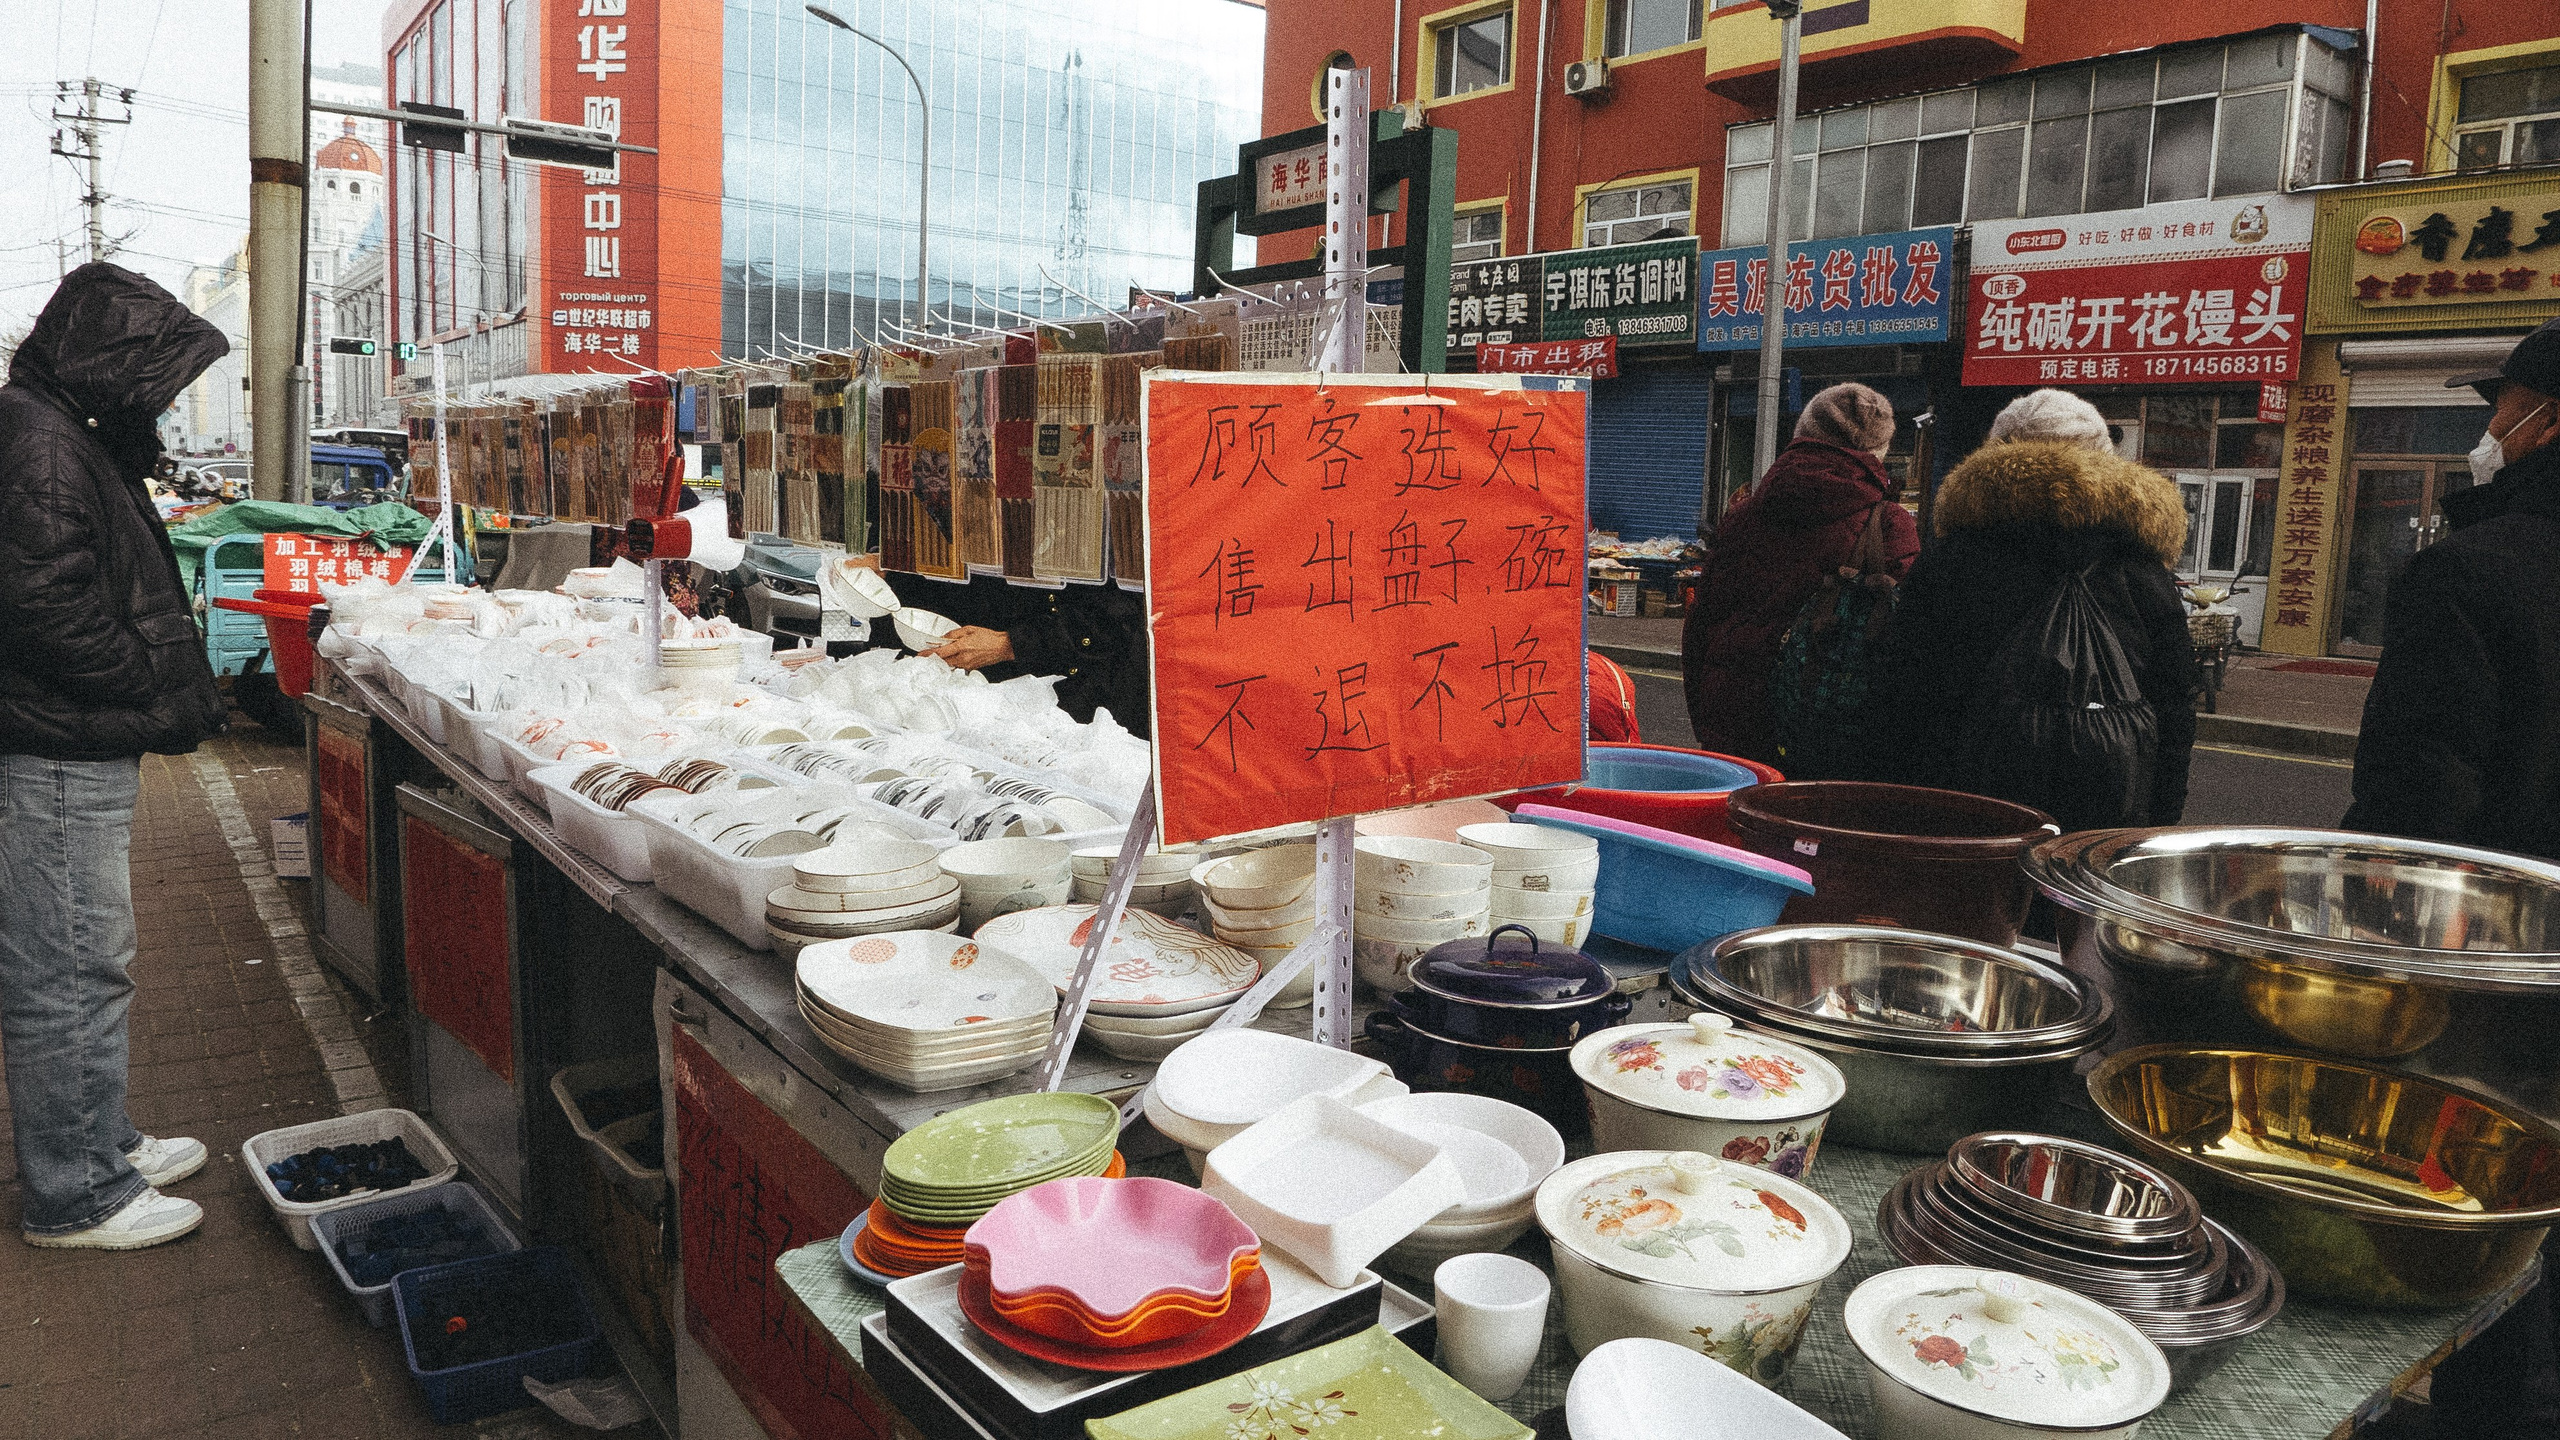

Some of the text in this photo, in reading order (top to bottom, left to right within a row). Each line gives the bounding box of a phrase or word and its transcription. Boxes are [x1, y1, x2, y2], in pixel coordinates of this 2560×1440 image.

[1270, 198, 1283, 207] HAI
[1286, 194, 1301, 205] HUA
[1546, 256, 1687, 312] 宇琪冻货调料
[1708, 240, 1941, 319] 昊源冻货批发
[1987, 278, 2020, 296] 顶香
[559, 291, 647, 304] торговый центр
[568, 308, 652, 329] 世纪华联超市
[1618, 315, 1687, 335] 13846331708
[1791, 322, 1820, 338] 海产品
[1823, 320, 1842, 336] 牛排
[1868, 317, 1939, 333] 13846351545
[1977, 285, 2296, 352] 纯碱开花馒头
[400, 343, 416, 360] 10
[564, 332, 640, 355] 海华二楼
[1481, 342, 1608, 367] 门市出租
[2144, 355, 2288, 377] 18714568315
[1189, 399, 1556, 497] 顾客选好
[2274, 384, 2337, 628] 现磨杂粮养生送来万家安康
[275, 537, 403, 559] 加工羽绒服
[289, 558, 391, 578] 羽绒棉裤
[1194, 624, 1563, 772] 不退不换
